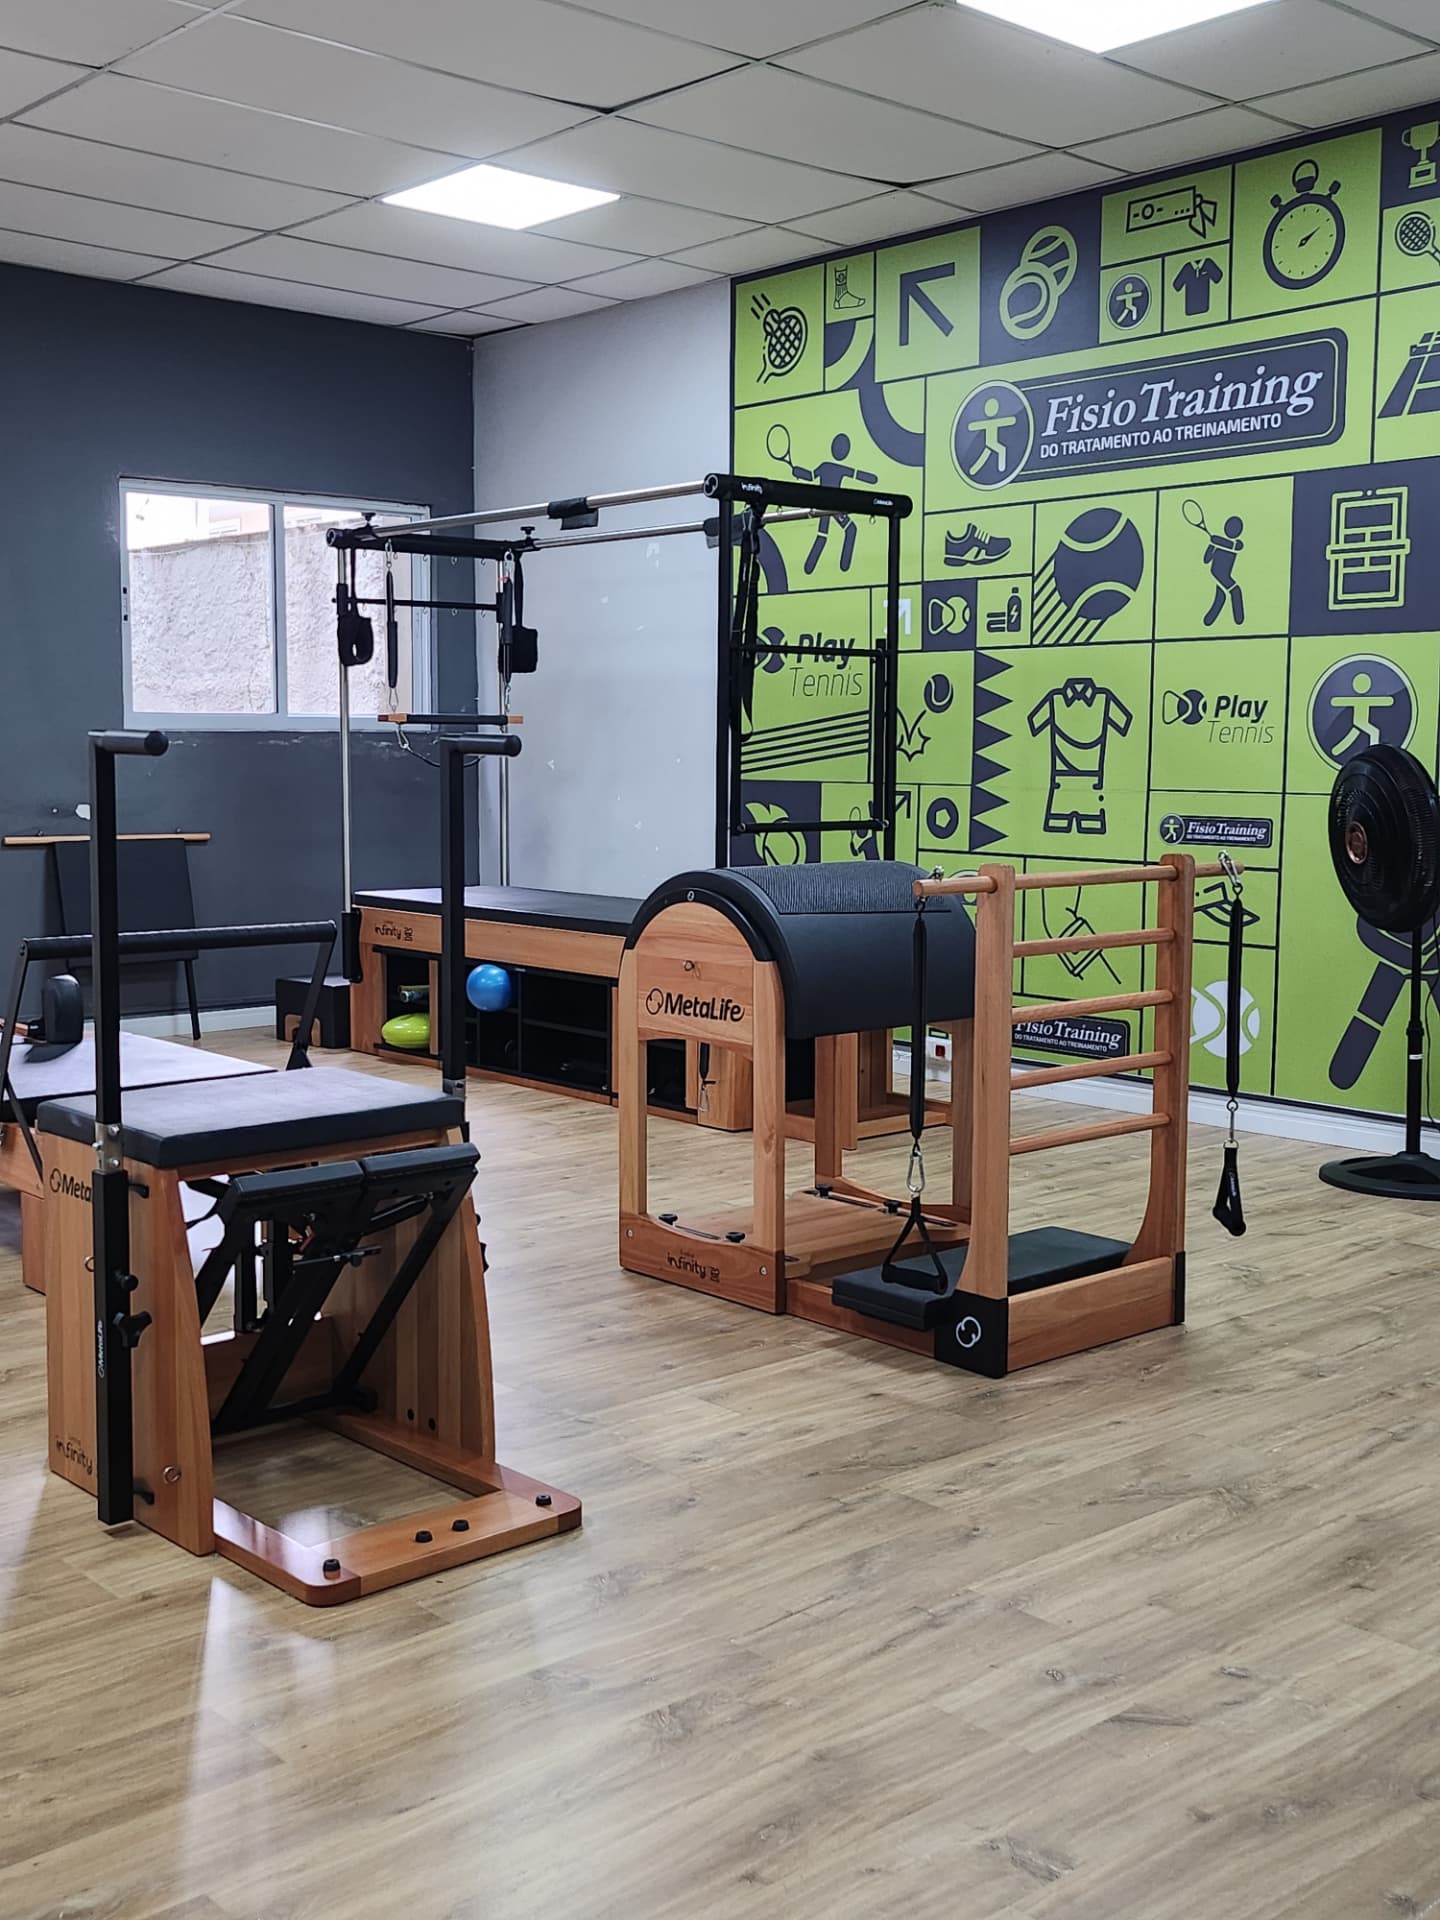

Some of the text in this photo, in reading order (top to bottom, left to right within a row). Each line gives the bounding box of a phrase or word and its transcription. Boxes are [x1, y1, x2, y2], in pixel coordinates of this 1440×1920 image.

[1040, 412, 1282, 459] DO TRATAMENTO AO TREINAMENTO
[797, 632, 855, 670] Play
[789, 665, 863, 697] Tennis
[1214, 694, 1269, 724] Play
[1207, 720, 1275, 744] Tennis
[664, 992, 746, 1022] MetaLife
[1023, 1033, 1058, 1045] TRATAMENTO
[1058, 1039, 1067, 1047] AO
[1067, 1040, 1107, 1052] TREINAMENTO
